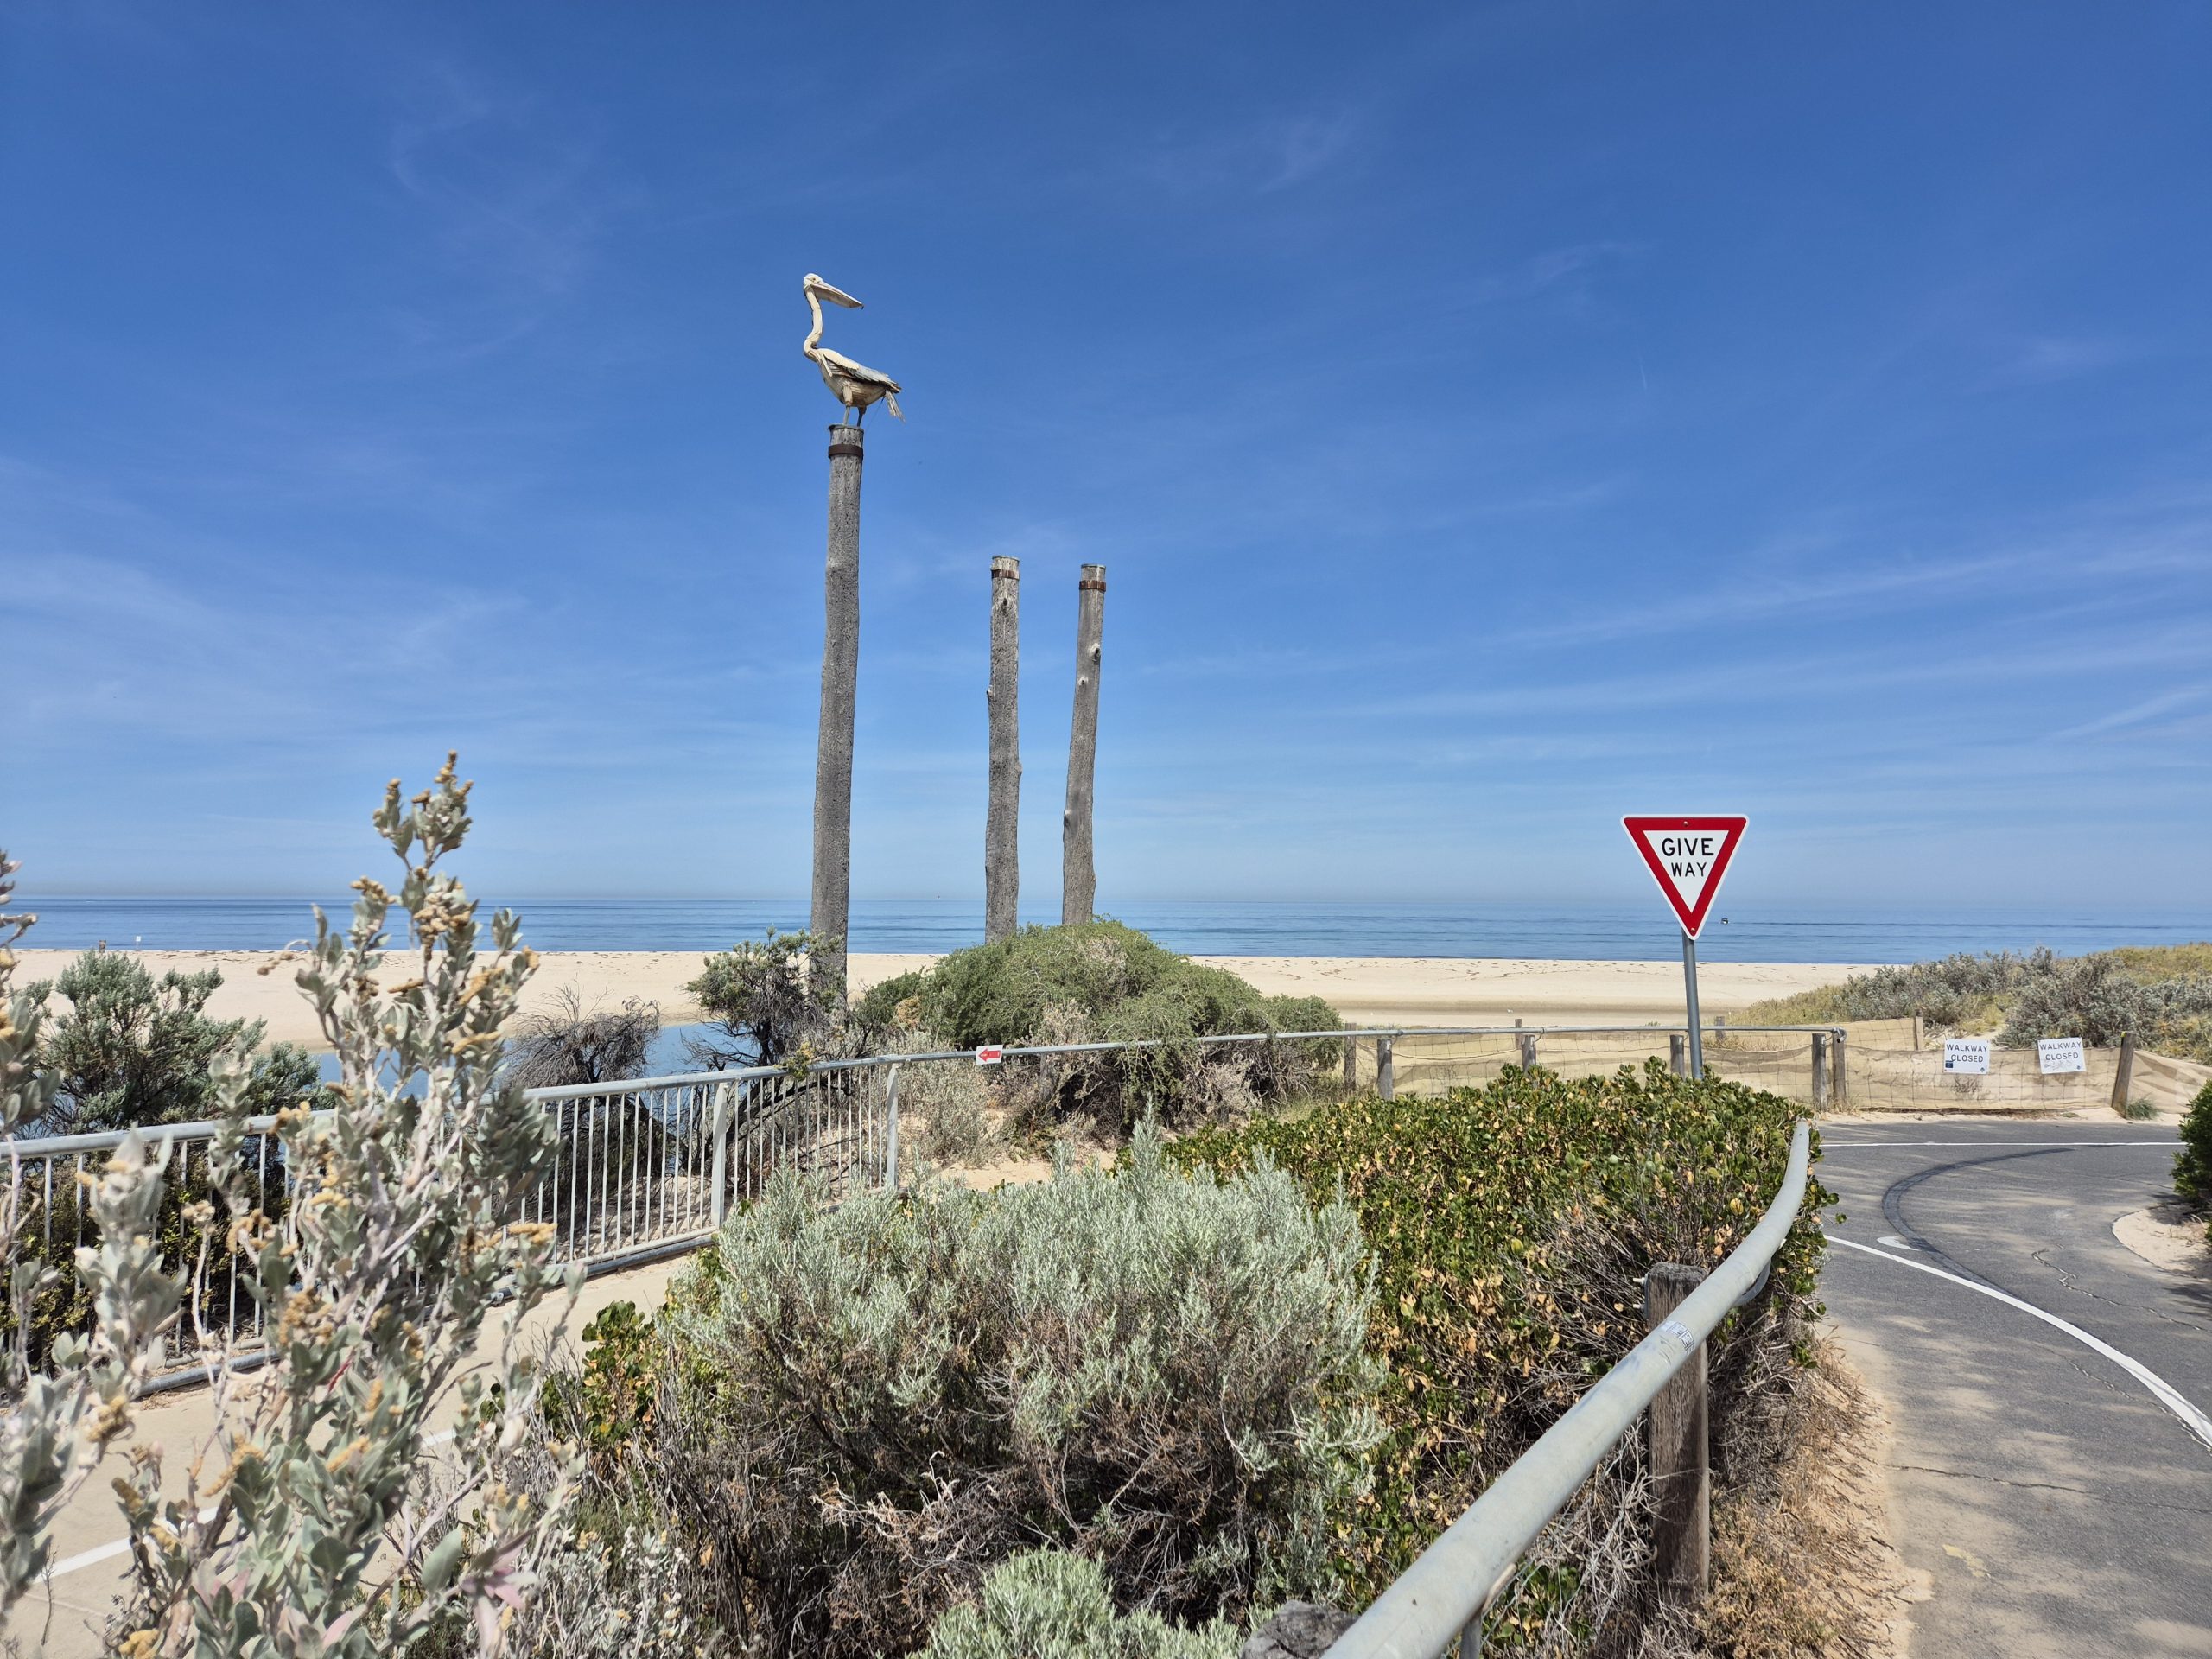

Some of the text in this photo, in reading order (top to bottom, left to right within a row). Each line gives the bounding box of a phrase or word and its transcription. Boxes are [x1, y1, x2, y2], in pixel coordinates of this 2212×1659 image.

[1662, 837, 1714, 856] GIVE
[1670, 861, 1707, 877] WAY
[1946, 1044, 1987, 1052] WALKWAY
[2039, 1041, 2082, 1051] WALKWAY
[1950, 1054, 1984, 1063] CLOSED
[2045, 1052, 2079, 1061] CLOSED
